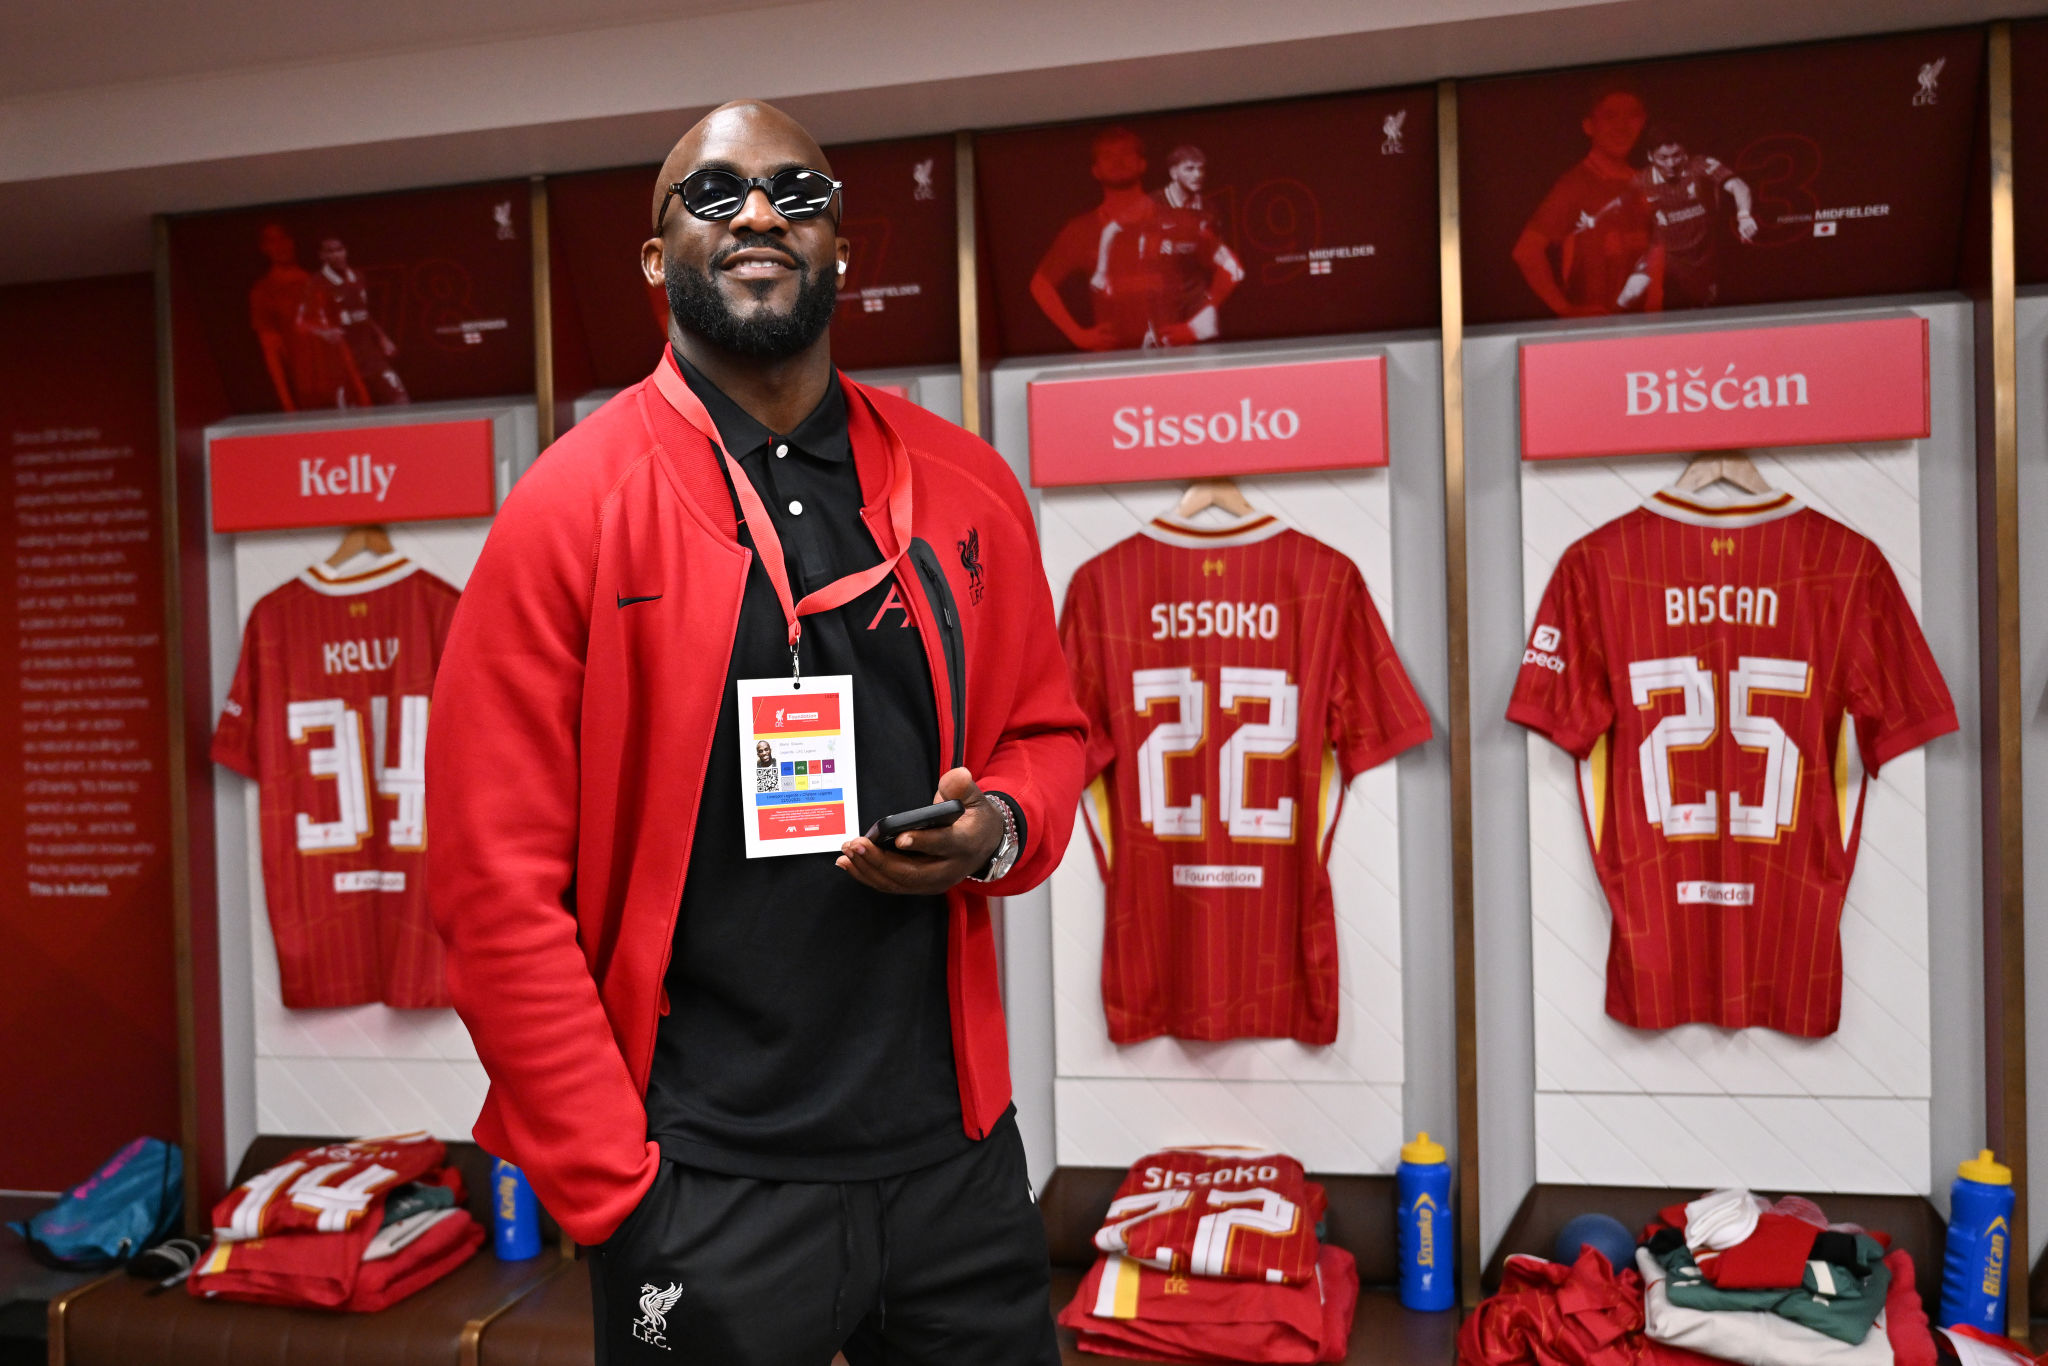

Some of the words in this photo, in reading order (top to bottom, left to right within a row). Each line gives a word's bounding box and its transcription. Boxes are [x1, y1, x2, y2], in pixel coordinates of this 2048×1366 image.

[1815, 203, 1890, 221] MIDFIELDER
[1308, 244, 1375, 260] MIDFIELDER
[1625, 363, 1809, 416] Bišćan
[1112, 397, 1300, 450] Sissoko
[299, 453, 397, 501] Kelly
[1151, 601, 1279, 640] SISSOKO
[1664, 585, 1779, 627] BISCAN
[323, 637, 400, 675] KELLY
[1132, 666, 1299, 844] 22
[1628, 656, 1812, 844] 25
[287, 694, 433, 854] 34
[1183, 869, 1256, 884] Foundation
[1142, 1166, 1279, 1189] SISSOKO
